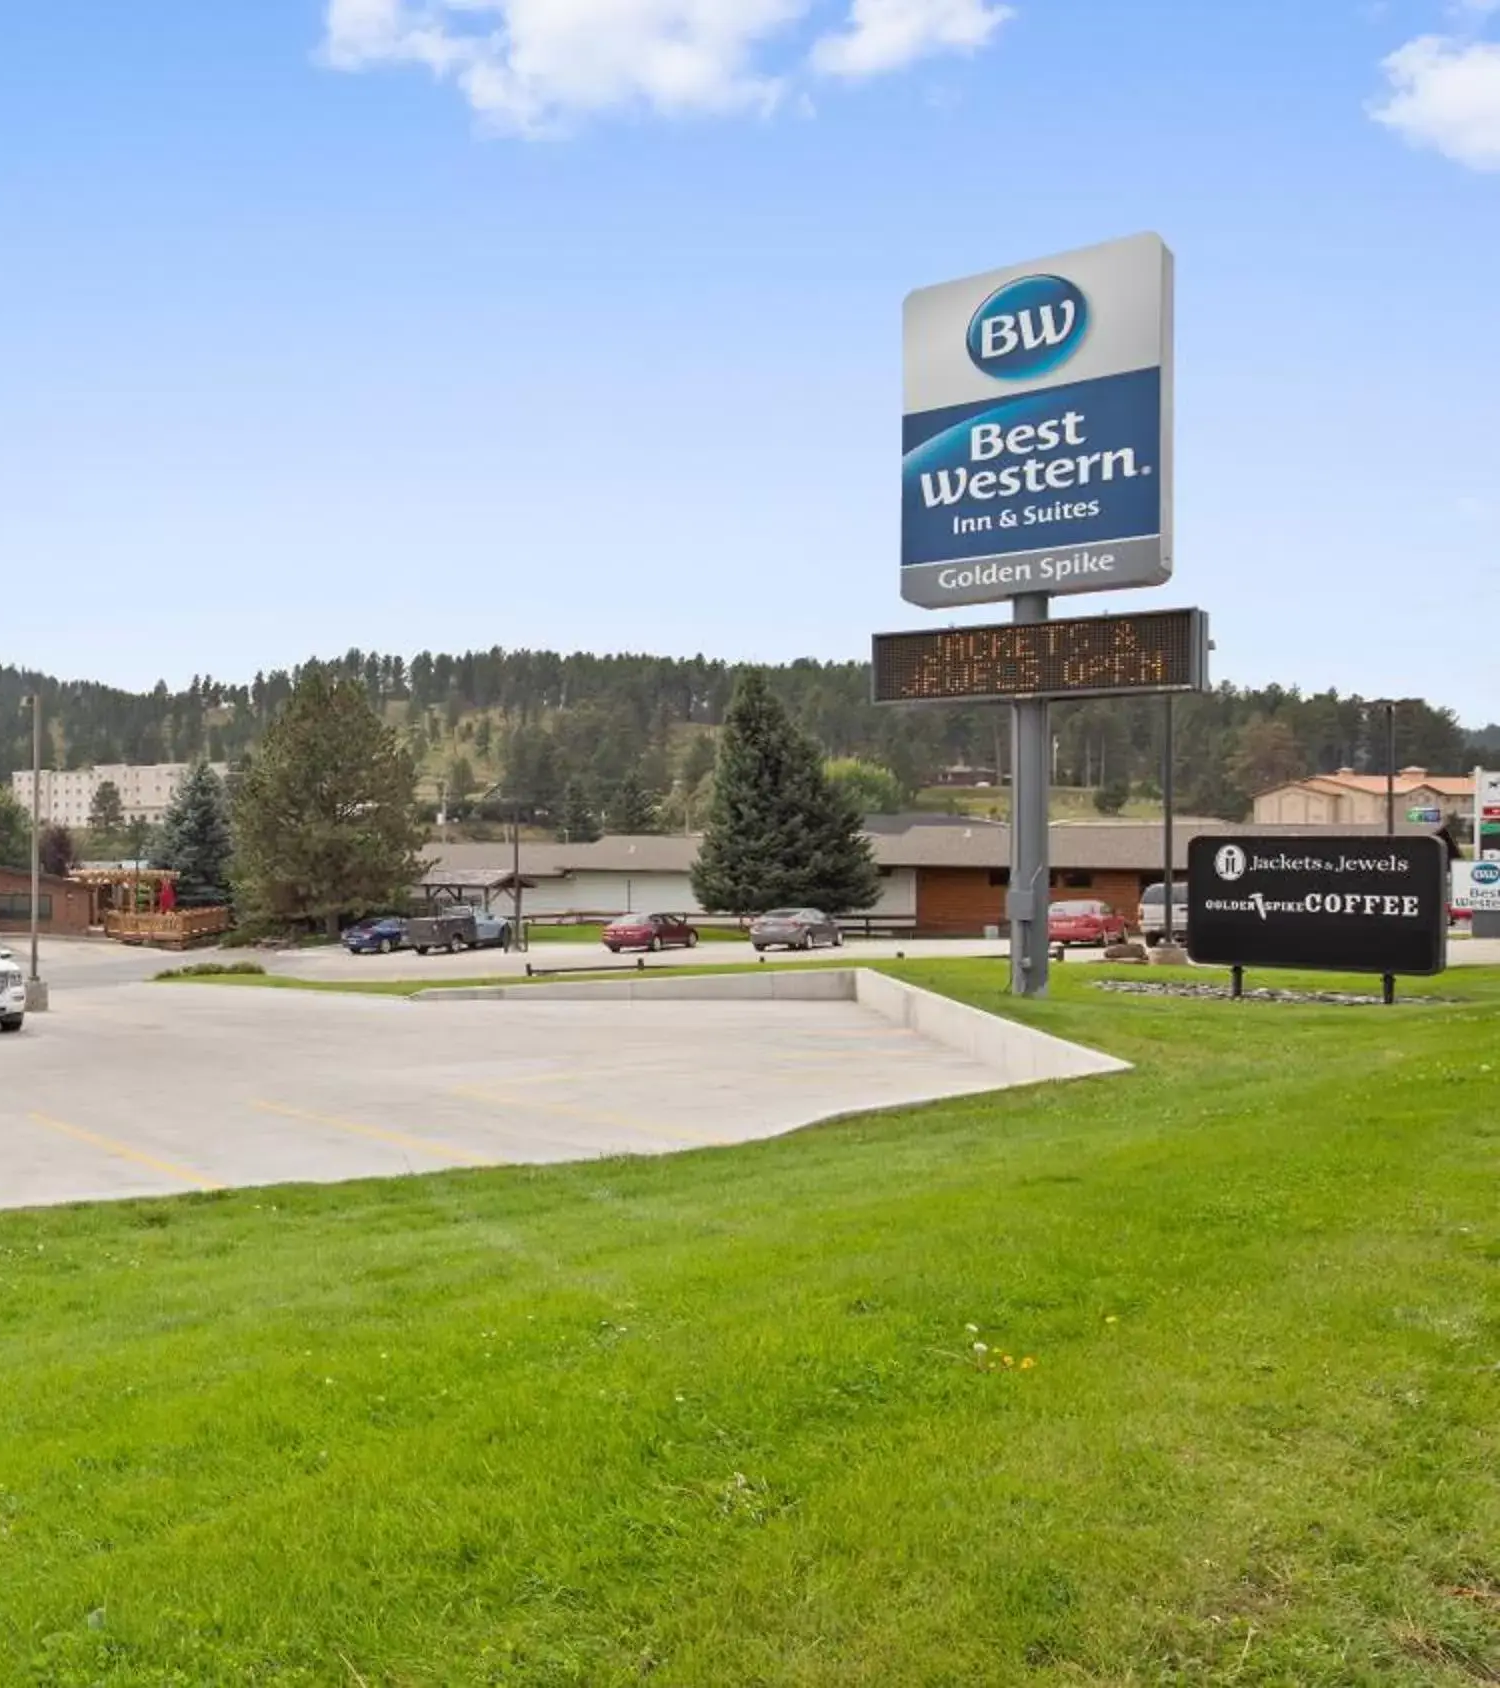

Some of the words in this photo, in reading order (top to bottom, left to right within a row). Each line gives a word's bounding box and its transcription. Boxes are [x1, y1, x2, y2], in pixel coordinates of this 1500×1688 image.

[981, 299, 1076, 358] BW
[970, 410, 1086, 461] Best
[953, 515, 992, 534] Inn
[999, 509, 1018, 528] &
[1023, 499, 1101, 526] Suites
[938, 557, 1032, 589] Golden
[1039, 551, 1117, 582] Spike
[1249, 853, 1322, 871] Jackets
[1334, 854, 1410, 873] Jewels
[1205, 899, 1255, 911] GOLDEN
[1263, 901, 1304, 912] SPIKE
[1304, 893, 1420, 917] COFFEE
